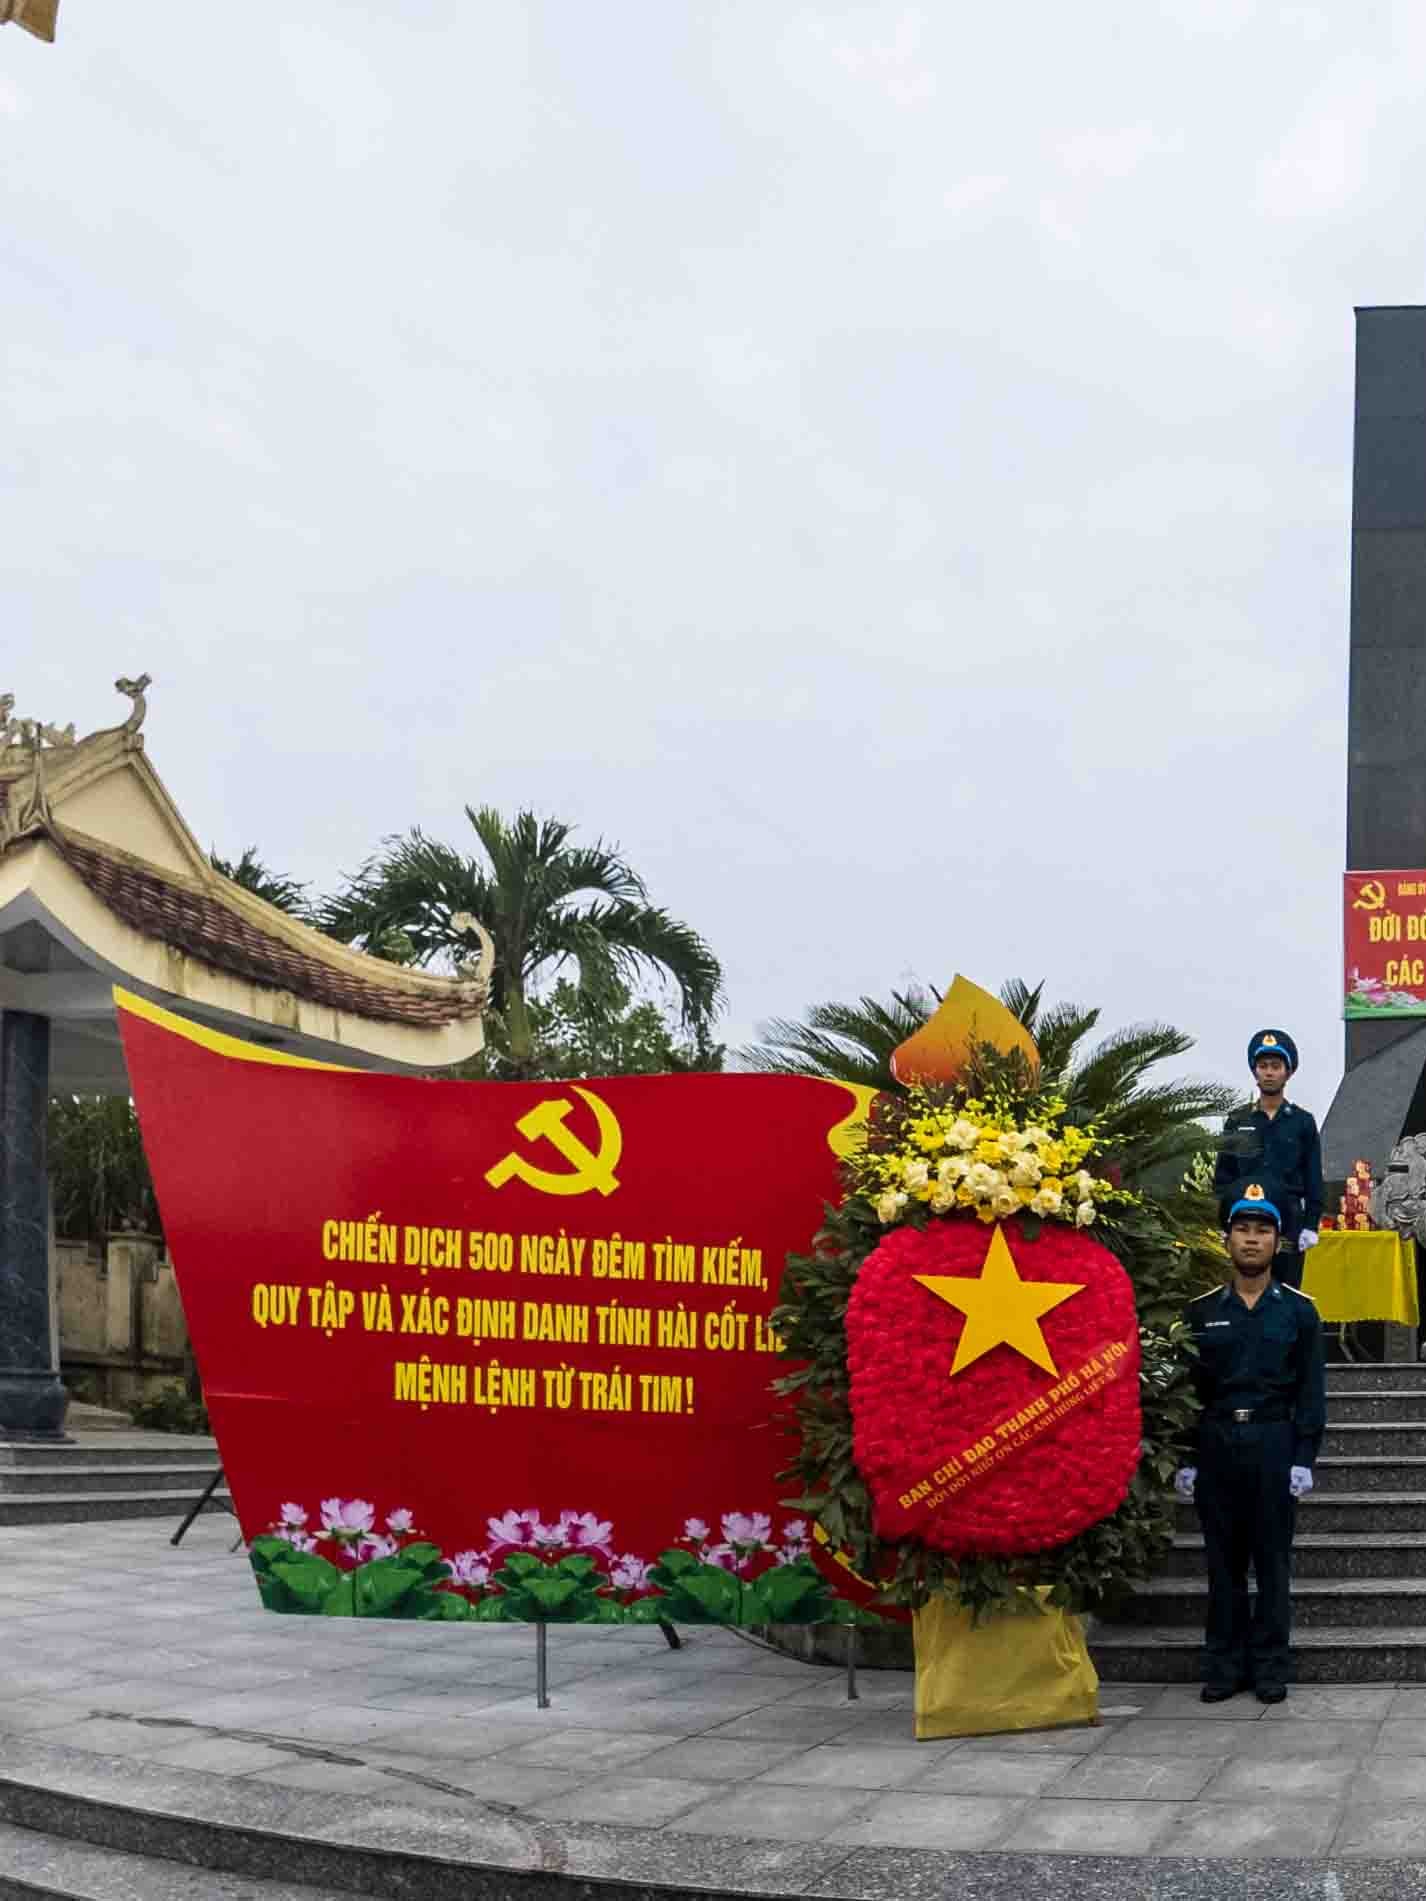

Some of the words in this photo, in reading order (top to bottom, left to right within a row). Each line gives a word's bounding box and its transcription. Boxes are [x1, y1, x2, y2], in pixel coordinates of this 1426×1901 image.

[1369, 910, 1401, 942] ĐỜI
[1385, 954, 1424, 985] CÁC
[323, 1211, 397, 1264] CHIẾN
[404, 1226, 462, 1275] DỊCH
[469, 1232, 513, 1272] 500
[521, 1229, 586, 1276] NGÀY
[592, 1232, 645, 1280] ĐÊM
[652, 1236, 695, 1282] TÌM
[702, 1237, 768, 1291] KIẾM,
[253, 1284, 301, 1328] QUY
[308, 1280, 354, 1336] TẬP
[362, 1284, 393, 1332] VÀ
[400, 1288, 449, 1335] XÁC
[456, 1298, 516, 1346] ĐỊNH
[523, 1302, 589, 1343] DANH
[596, 1299, 650, 1346] TÍNH
[658, 1302, 696, 1348] HÀI
[704, 1300, 749, 1350] CỐT
[755, 1315, 788, 1352] LI
[395, 1355, 466, 1410] MỆNH
[474, 1360, 535, 1414] LỆNH
[543, 1362, 577, 1410] TỪ
[579, 1365, 631, 1411] TRÁI
[639, 1375, 693, 1414] TIM!
[899, 1480, 932, 1509] BAN
